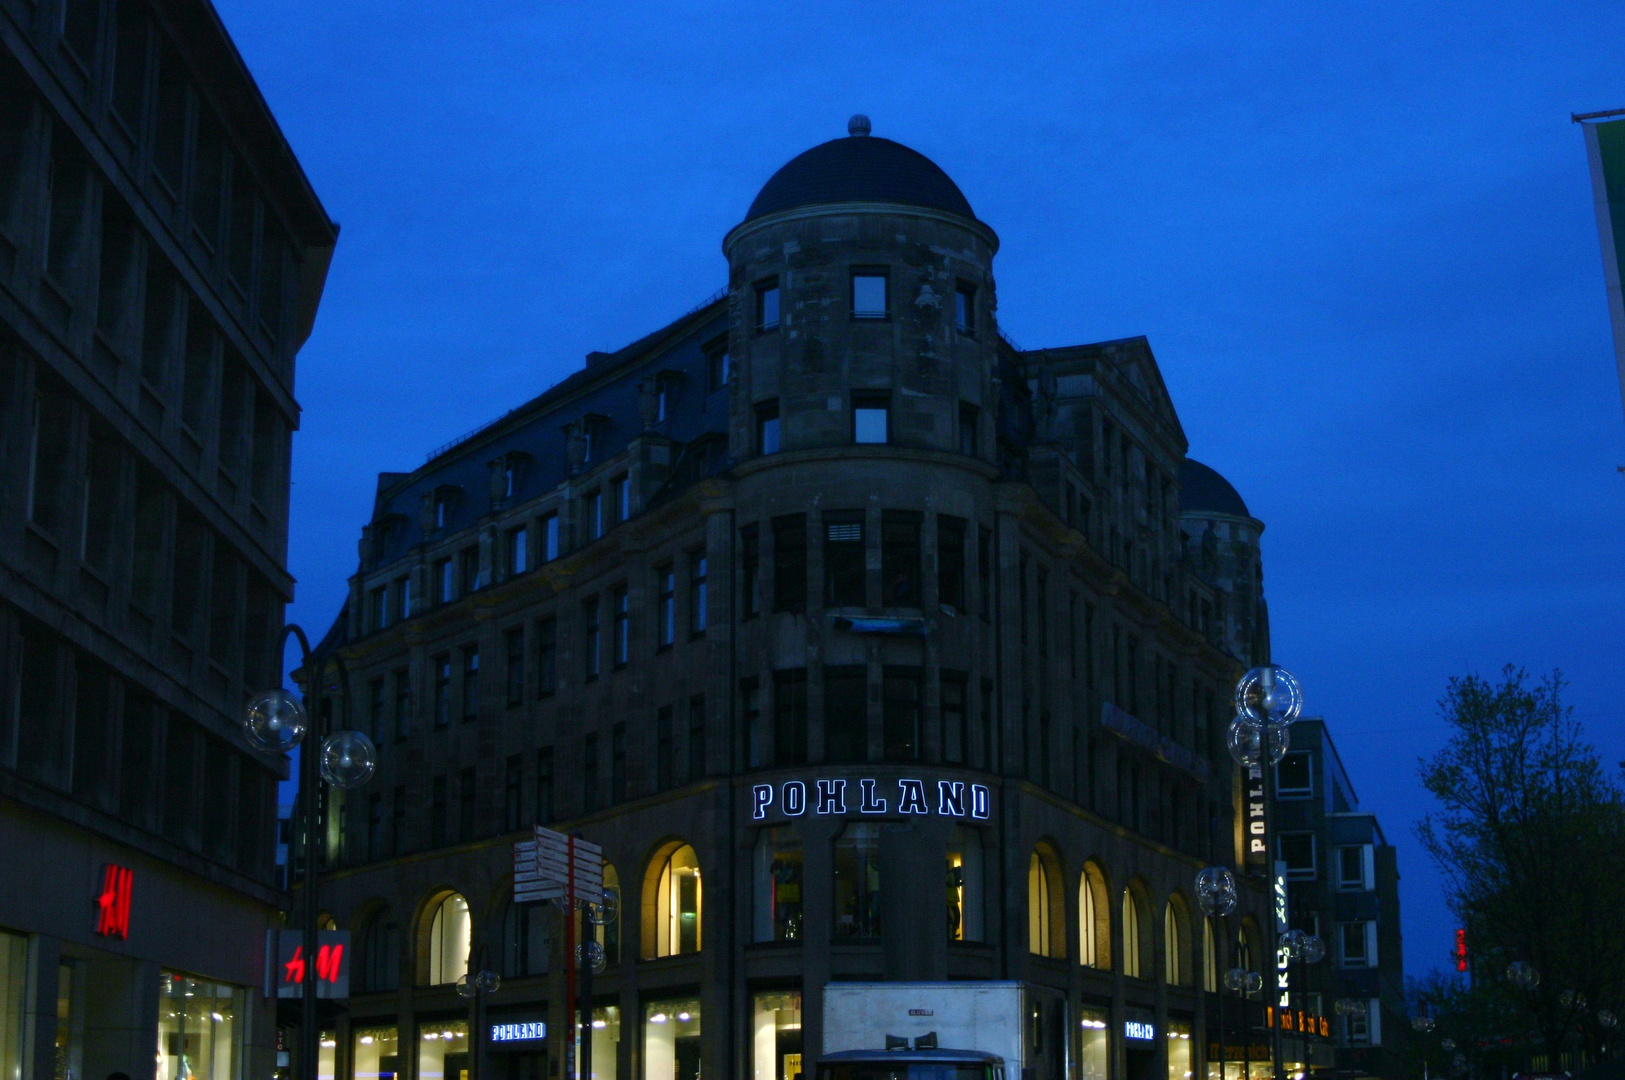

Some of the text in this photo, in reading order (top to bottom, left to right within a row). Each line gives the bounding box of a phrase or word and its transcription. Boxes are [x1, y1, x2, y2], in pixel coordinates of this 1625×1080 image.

[752, 778, 991, 820] POHLAND
[284, 943, 344, 984] HM
[491, 1022, 545, 1041] POHLAND
